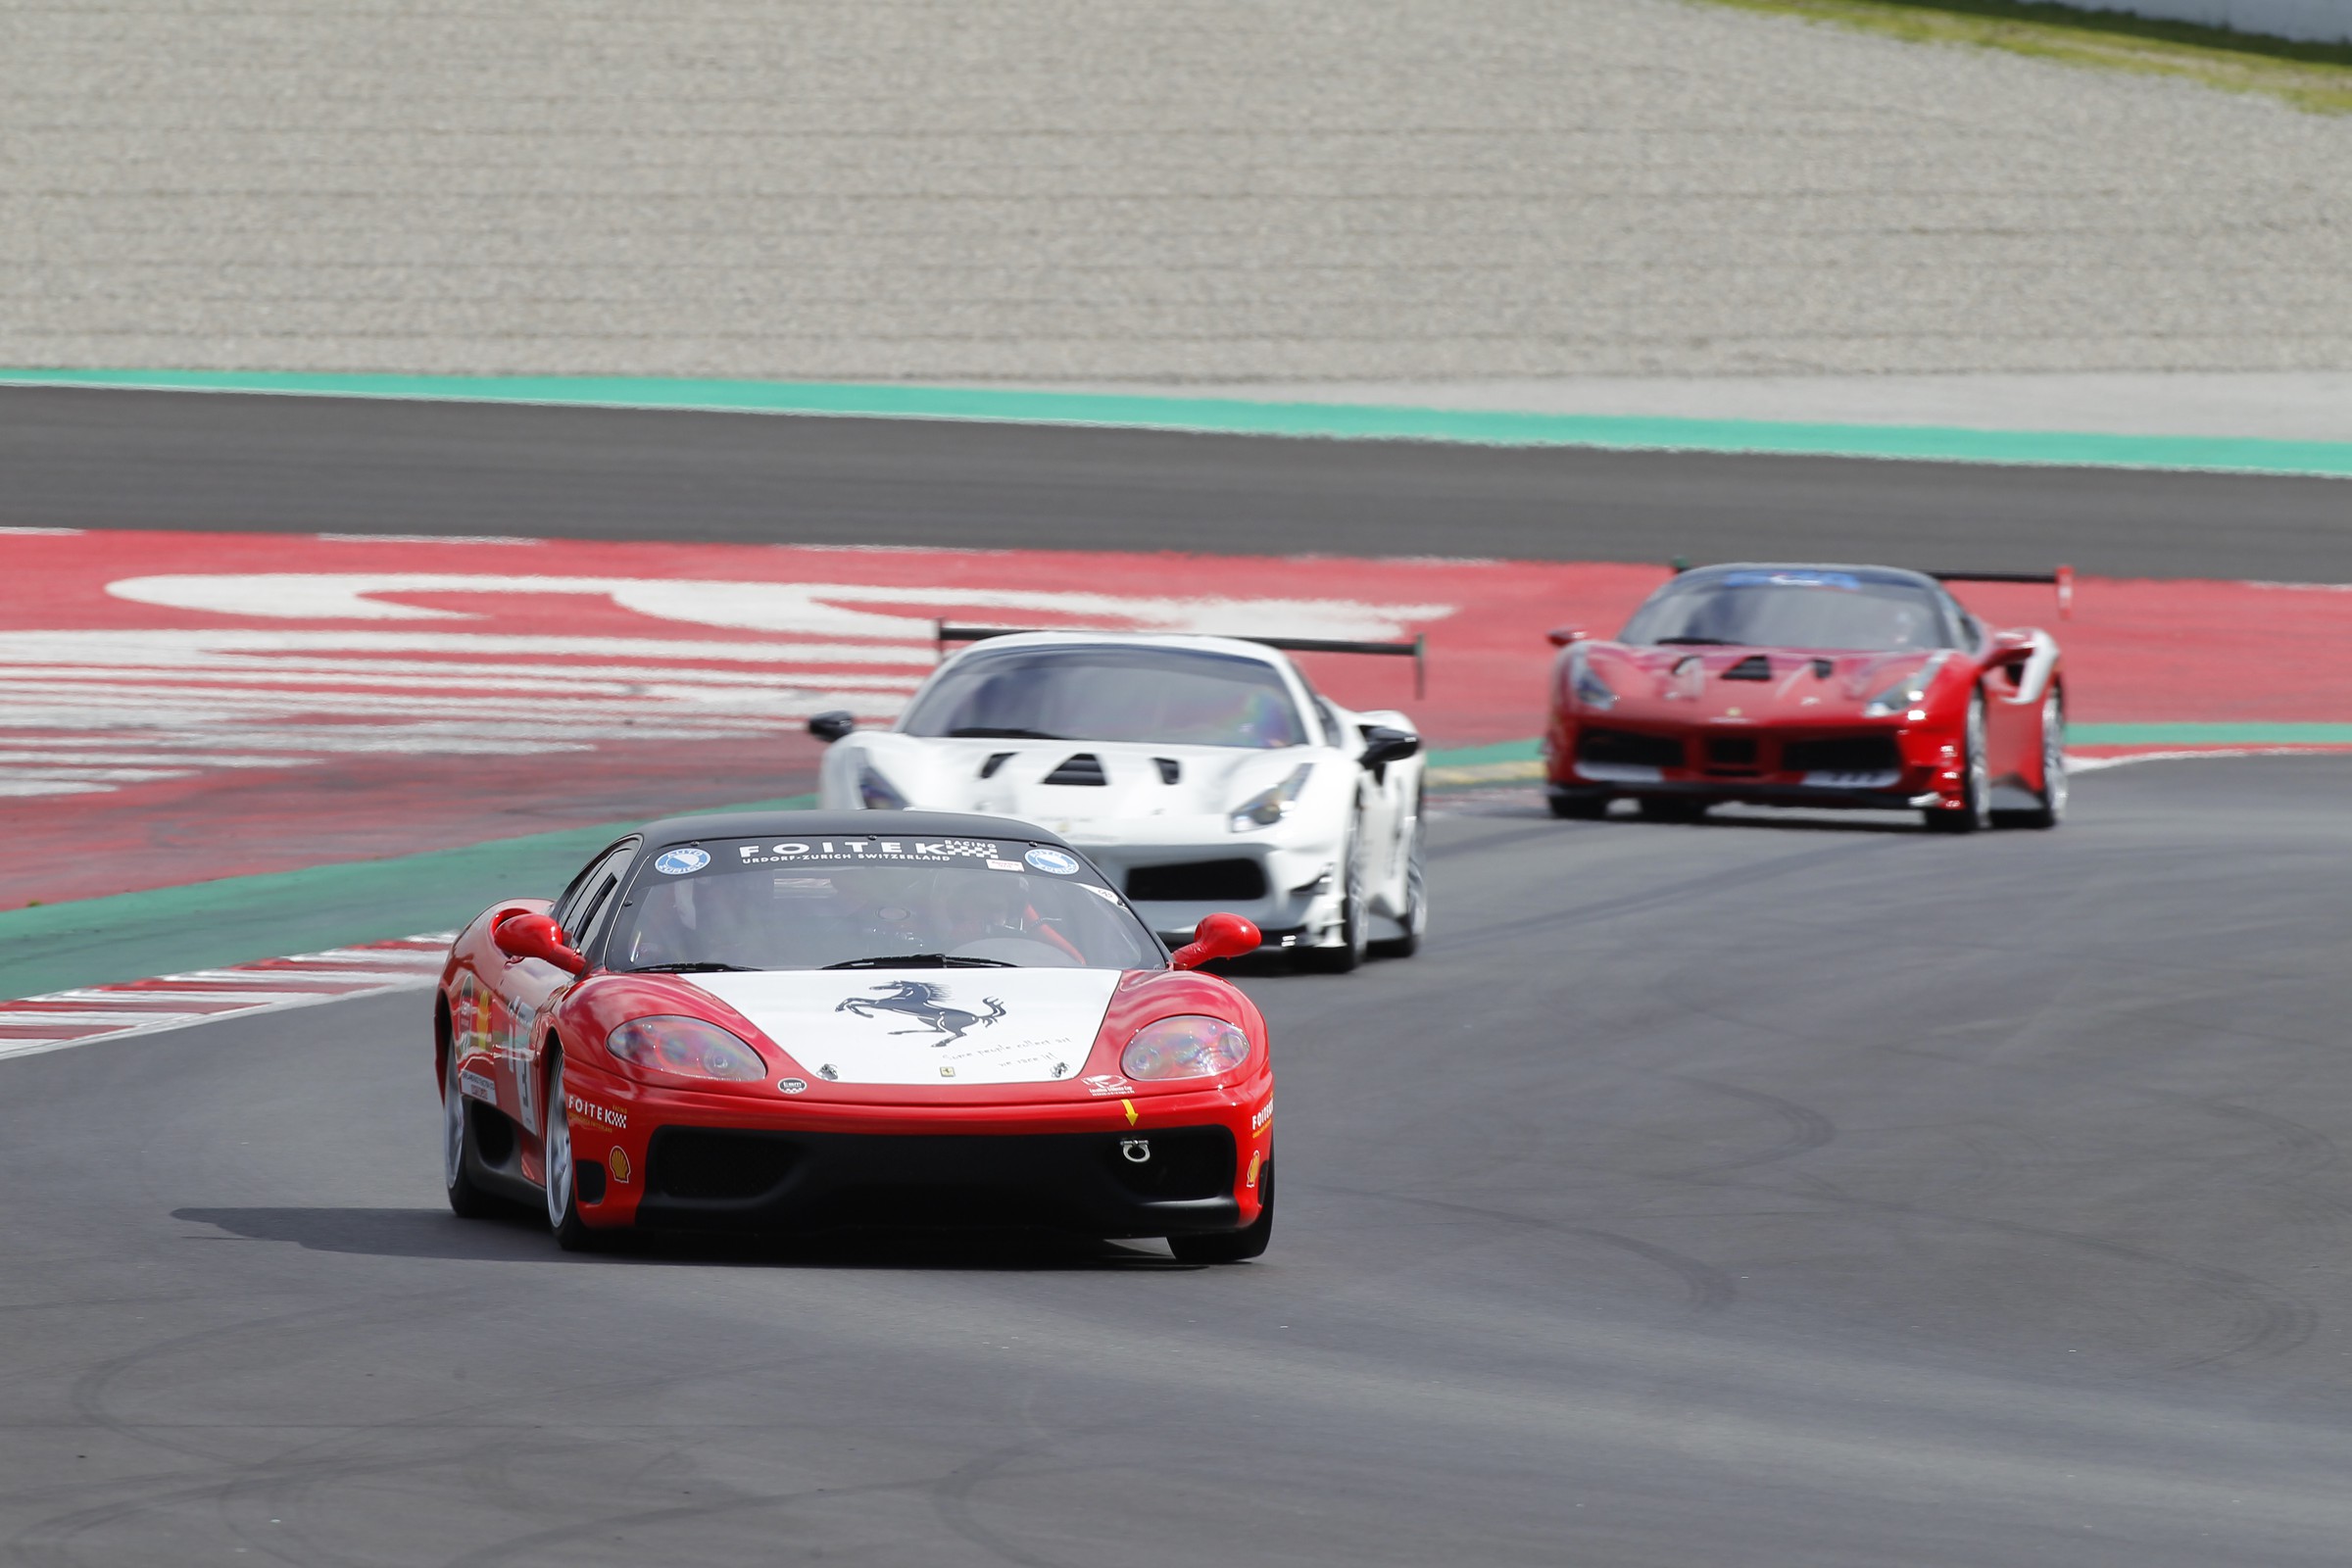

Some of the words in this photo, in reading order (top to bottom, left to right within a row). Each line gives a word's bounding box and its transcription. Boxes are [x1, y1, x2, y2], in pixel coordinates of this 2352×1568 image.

[739, 841, 947, 858] FOITEK
[945, 839, 997, 849] RACING
[742, 854, 852, 864] URDORF-ZURICH
[978, 1044, 1011, 1057] people
[568, 1095, 613, 1125] FOITEK
